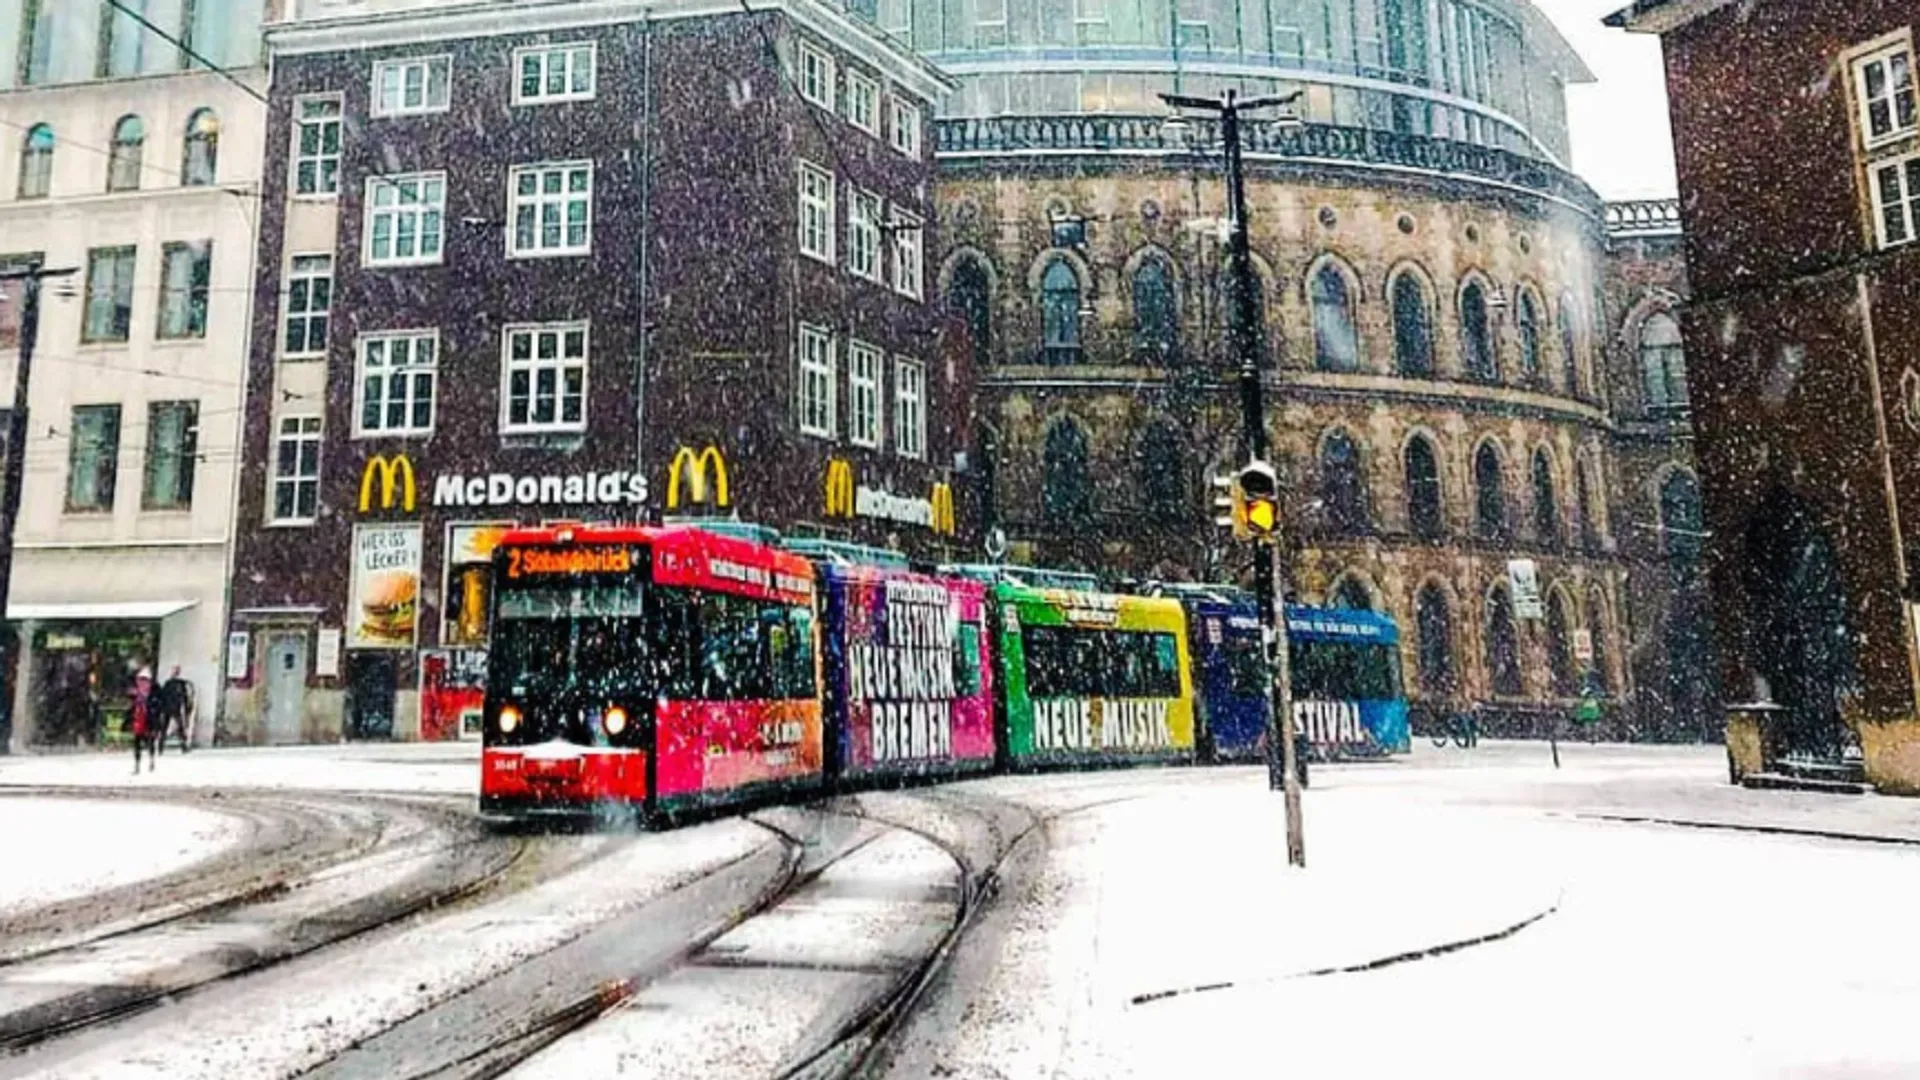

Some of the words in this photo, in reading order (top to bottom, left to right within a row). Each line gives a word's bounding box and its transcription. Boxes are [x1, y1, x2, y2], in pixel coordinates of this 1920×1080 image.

[434, 472, 648, 506] McDonald's
[508, 547, 520, 577] 2
[850, 645, 899, 701] NEUE
[871, 700, 951, 762] BREMEN
[1034, 699, 1092, 750] NEUE
[1101, 697, 1172, 752] MUSIK
[1293, 699, 1365, 744] STIVAL
